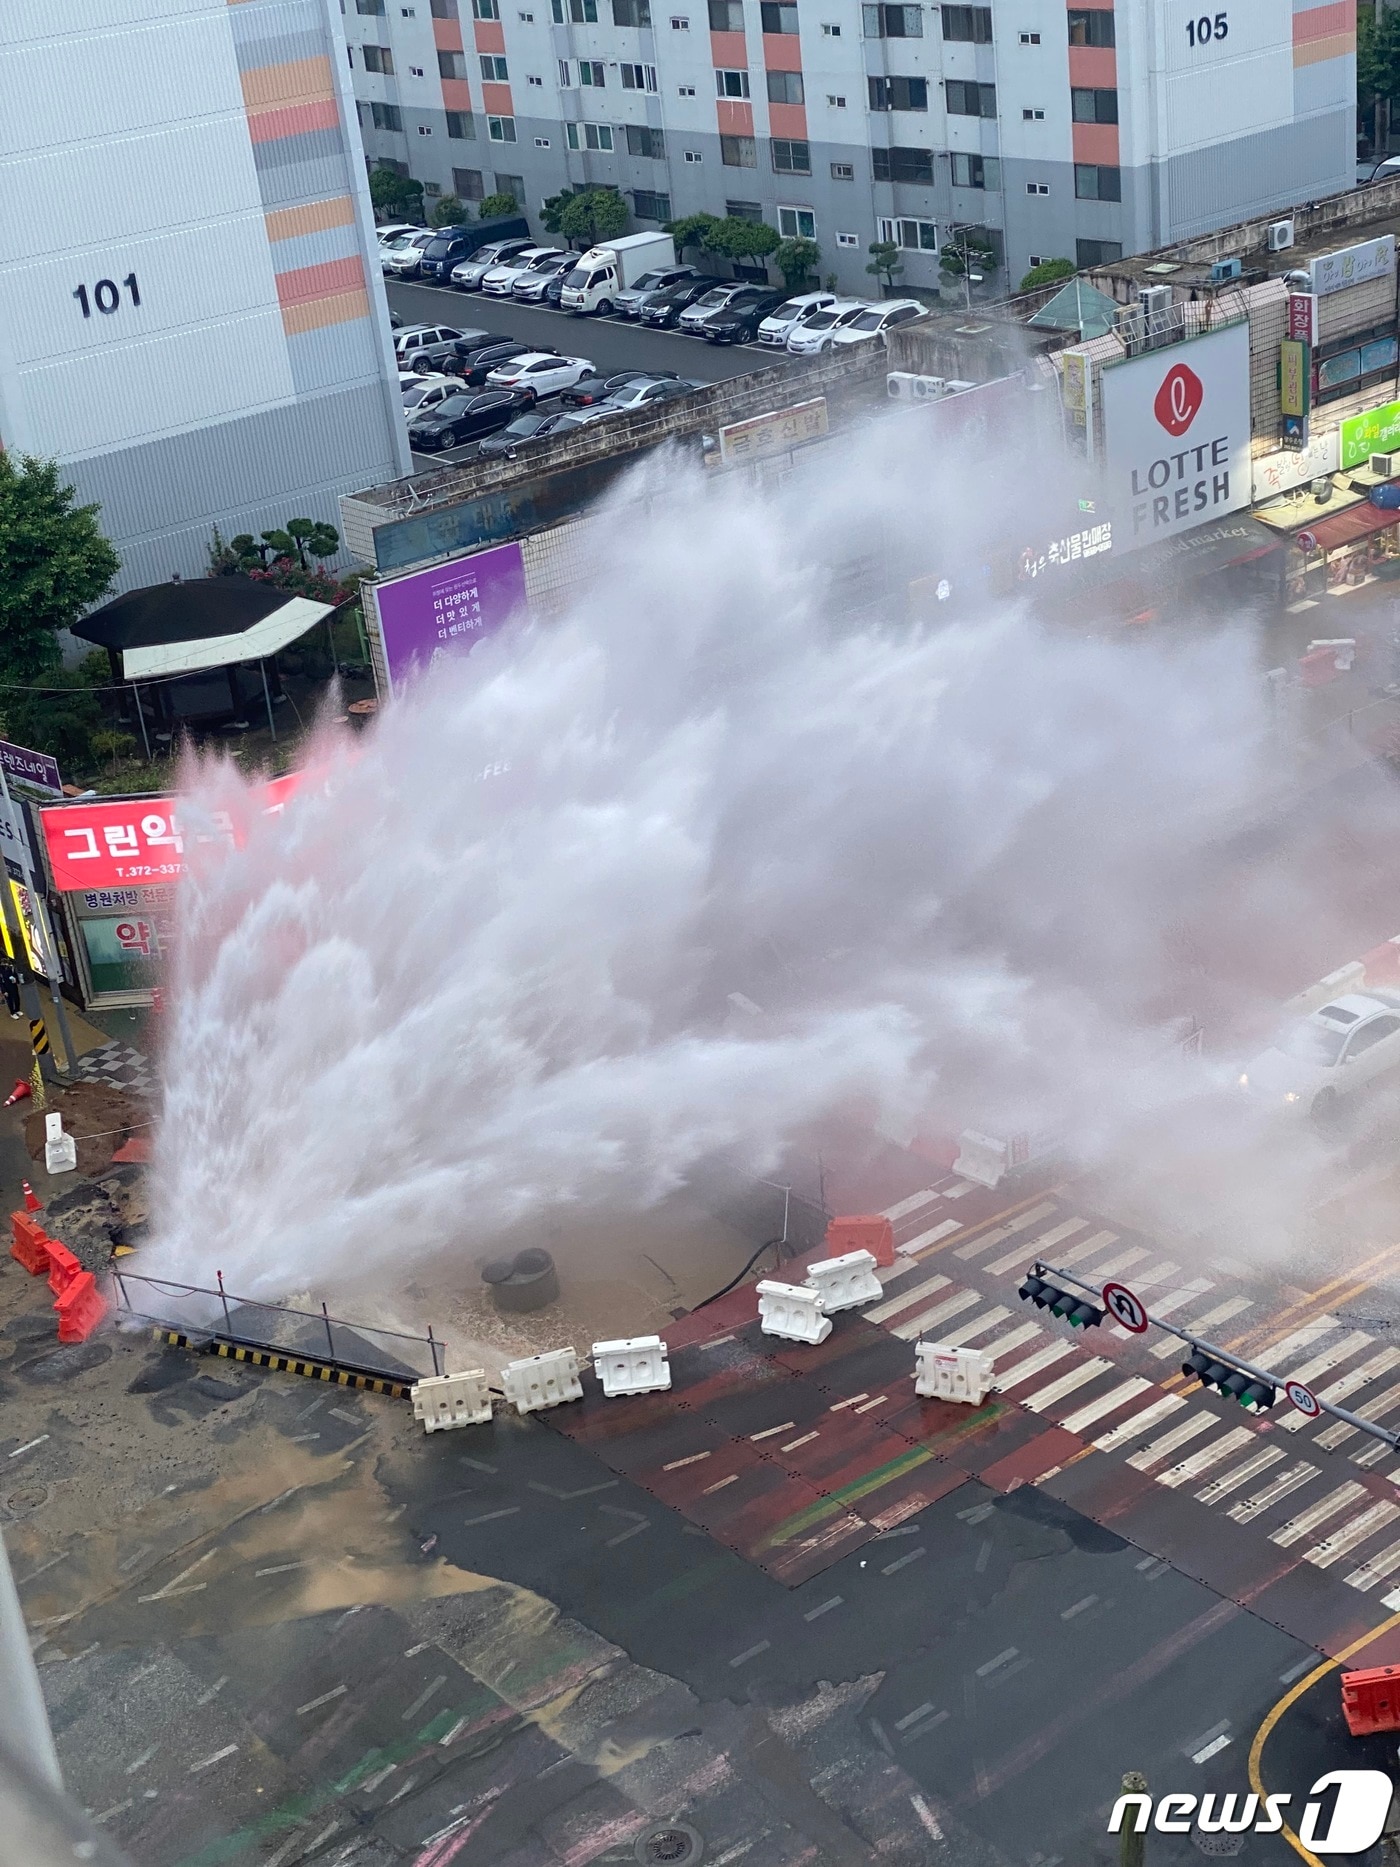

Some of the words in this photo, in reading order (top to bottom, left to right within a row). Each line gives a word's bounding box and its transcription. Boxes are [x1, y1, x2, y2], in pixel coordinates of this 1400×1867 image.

[1186, 12, 1228, 47] 105
[73, 273, 140, 318] 101
[1131, 436, 1228, 496] LOTTE
[1133, 471, 1229, 536] FRESH
[1188, 526, 1249, 547] market
[433, 599, 443, 610] 더
[444, 587, 479, 606] 다양하게
[436, 613, 445, 624] 더
[438, 628, 447, 639] 더
[84, 890, 139, 909] 병원처방
[1295, 1391, 1311, 1408] 50
